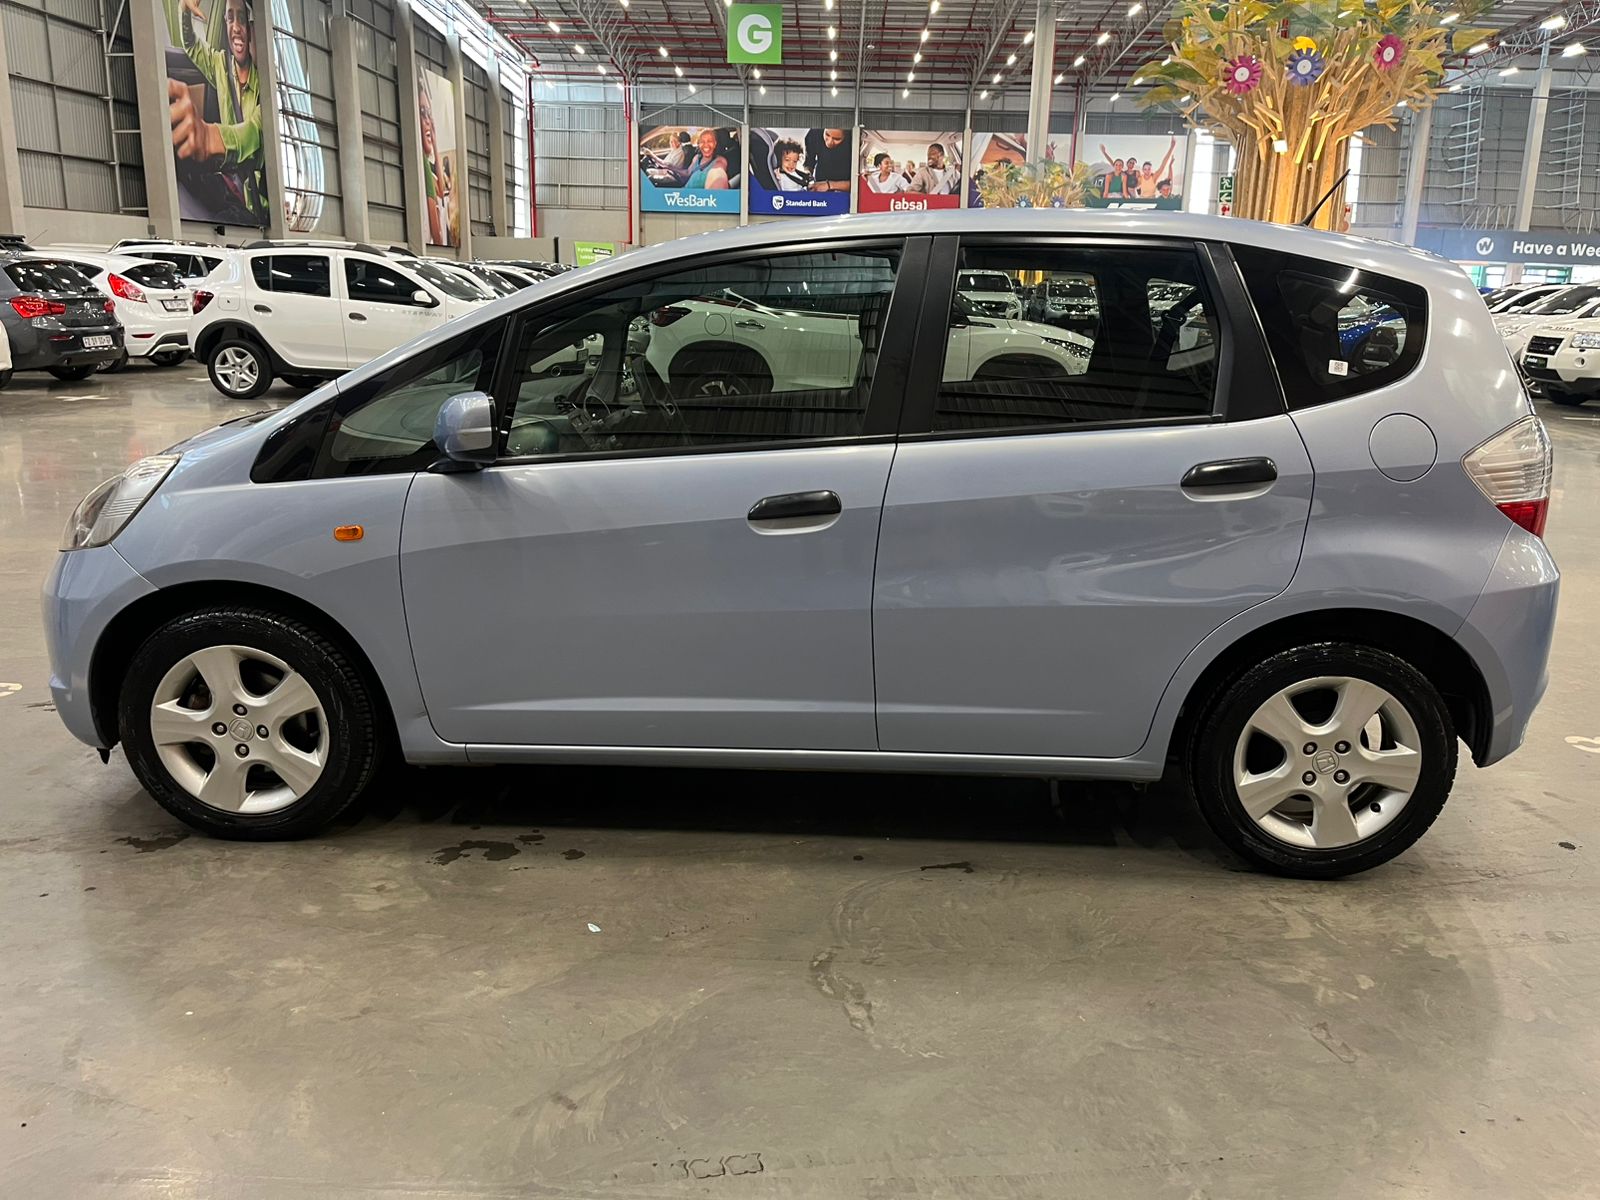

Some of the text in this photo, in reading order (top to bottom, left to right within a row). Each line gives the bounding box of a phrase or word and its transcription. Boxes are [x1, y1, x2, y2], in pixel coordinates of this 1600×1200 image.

[737, 13, 773, 54] G
[664, 191, 717, 207] WesBank
[785, 199, 812, 207] Standard
[1512, 241, 1554, 255] Have
[1556, 244, 1567, 256] a
